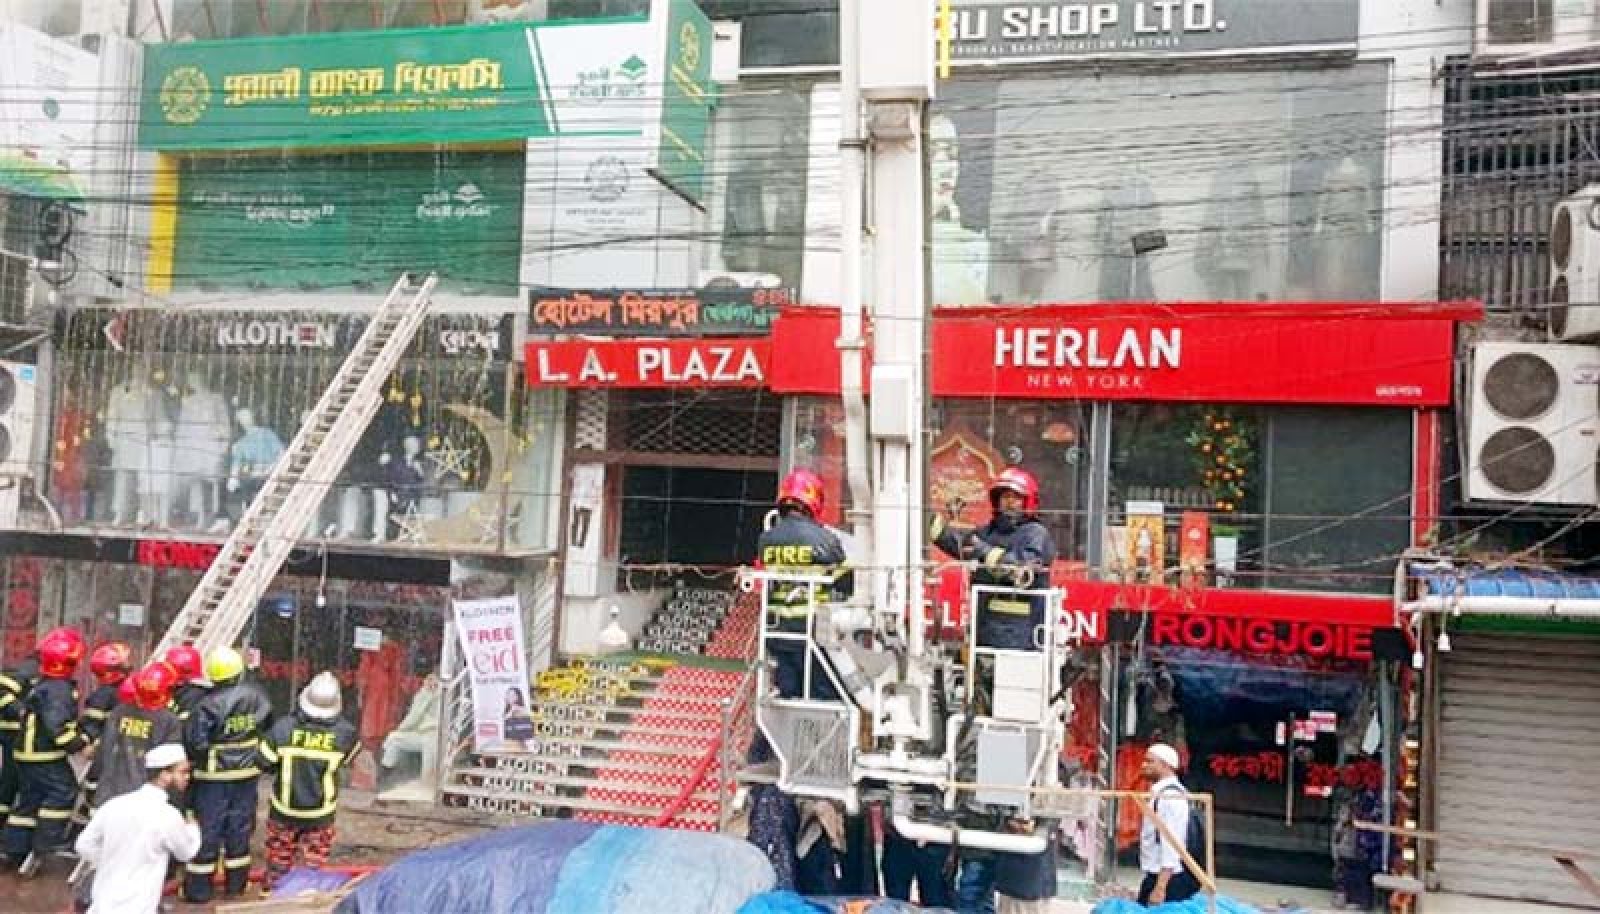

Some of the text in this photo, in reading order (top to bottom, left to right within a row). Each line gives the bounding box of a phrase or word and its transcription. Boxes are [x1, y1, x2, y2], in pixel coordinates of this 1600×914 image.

[1002, 3, 1118, 38] SHOP
[1134, 0, 1226, 33] LTD.
[994, 327, 1182, 370] HERLAN
[637, 347, 764, 381] PLAZA
[1027, 374, 1144, 389] NEW YORK
[763, 545, 813, 563] FIRE
[467, 627, 514, 643] FREE
[1153, 614, 1373, 660] RONGJOIE
[118, 716, 153, 739] FIRE
[290, 729, 336, 750] FIRE
